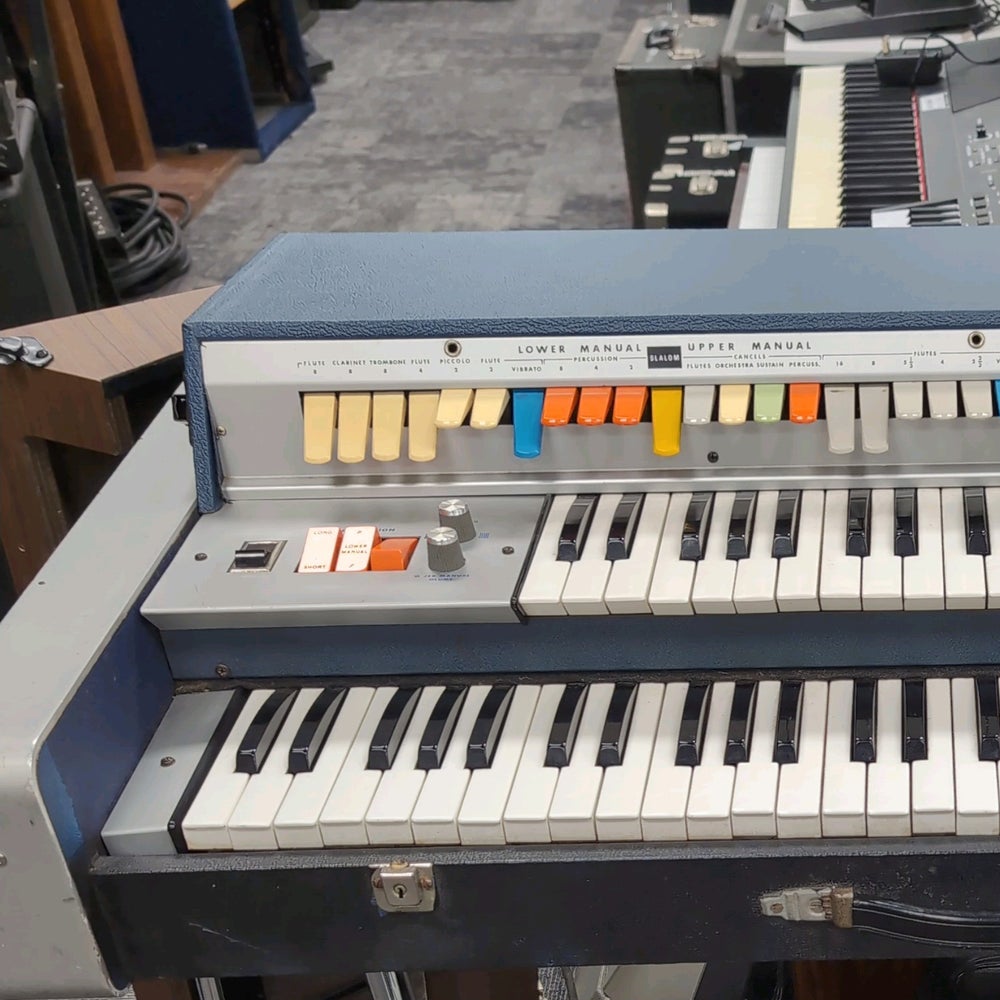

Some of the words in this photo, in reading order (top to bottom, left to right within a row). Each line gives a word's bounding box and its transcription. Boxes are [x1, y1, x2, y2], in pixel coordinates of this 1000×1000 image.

[518, 345, 566, 354] LOWER
[579, 343, 642, 353] MANUAL
[687, 342, 735, 351] UPPER
[752, 341, 812, 351] MANUAL
[649, 354, 680, 362] SLALOM
